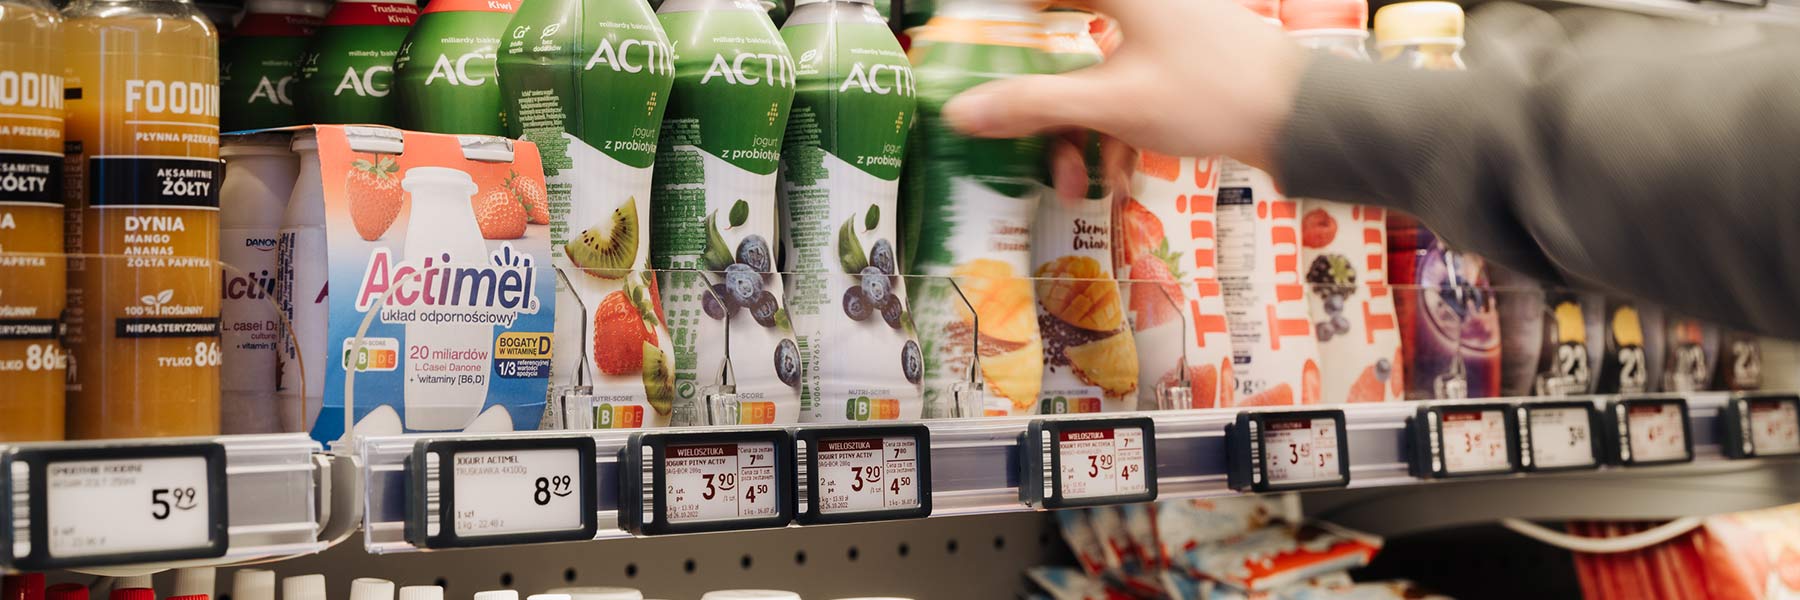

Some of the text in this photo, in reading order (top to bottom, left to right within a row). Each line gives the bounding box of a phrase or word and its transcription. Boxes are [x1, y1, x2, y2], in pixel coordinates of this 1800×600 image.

[388, 14, 410, 24] Kiwi
[136, 132, 180, 142] PŁYNNA
[632, 128, 655, 138] jogurt
[605, 140, 612, 149] z
[752, 136, 778, 148] jogurt
[722, 150, 729, 158] z
[857, 156, 864, 164] z
[157, 168, 212, 180] AKSAMITNIE
[0, 172, 47, 192] ÓŁTY
[162, 177, 210, 196] ŻÓŁTY
[125, 216, 185, 232] DYNIA
[124, 234, 170, 244] MANGO
[124, 246, 174, 255] ANANAS
[359, 252, 533, 310] Actimel
[161, 303, 204, 316] ROŚLINNY
[382, 310, 416, 322] układ
[126, 324, 216, 334] NIEPASTERYZOWANY
[233, 320, 262, 331] casei
[242, 342, 269, 350] vitamin
[500, 338, 538, 348] BOGATY
[507, 348, 537, 356] WITAMINĘ
[539, 336, 550, 355] D
[410, 345, 488, 361] 20 miliardów
[158, 357, 192, 367] TYLKO
[449, 364, 482, 372] Danone
[499, 362, 516, 376] 1/3
[828, 442, 870, 450] WIELOSZTUKA
[678, 448, 724, 456] WIELOSZTUKA
[458, 456, 520, 465] JOGURT ACTIMEL
[689, 458, 706, 466] PITNY
[820, 478, 826, 486] 2
[668, 486, 673, 494] 2
